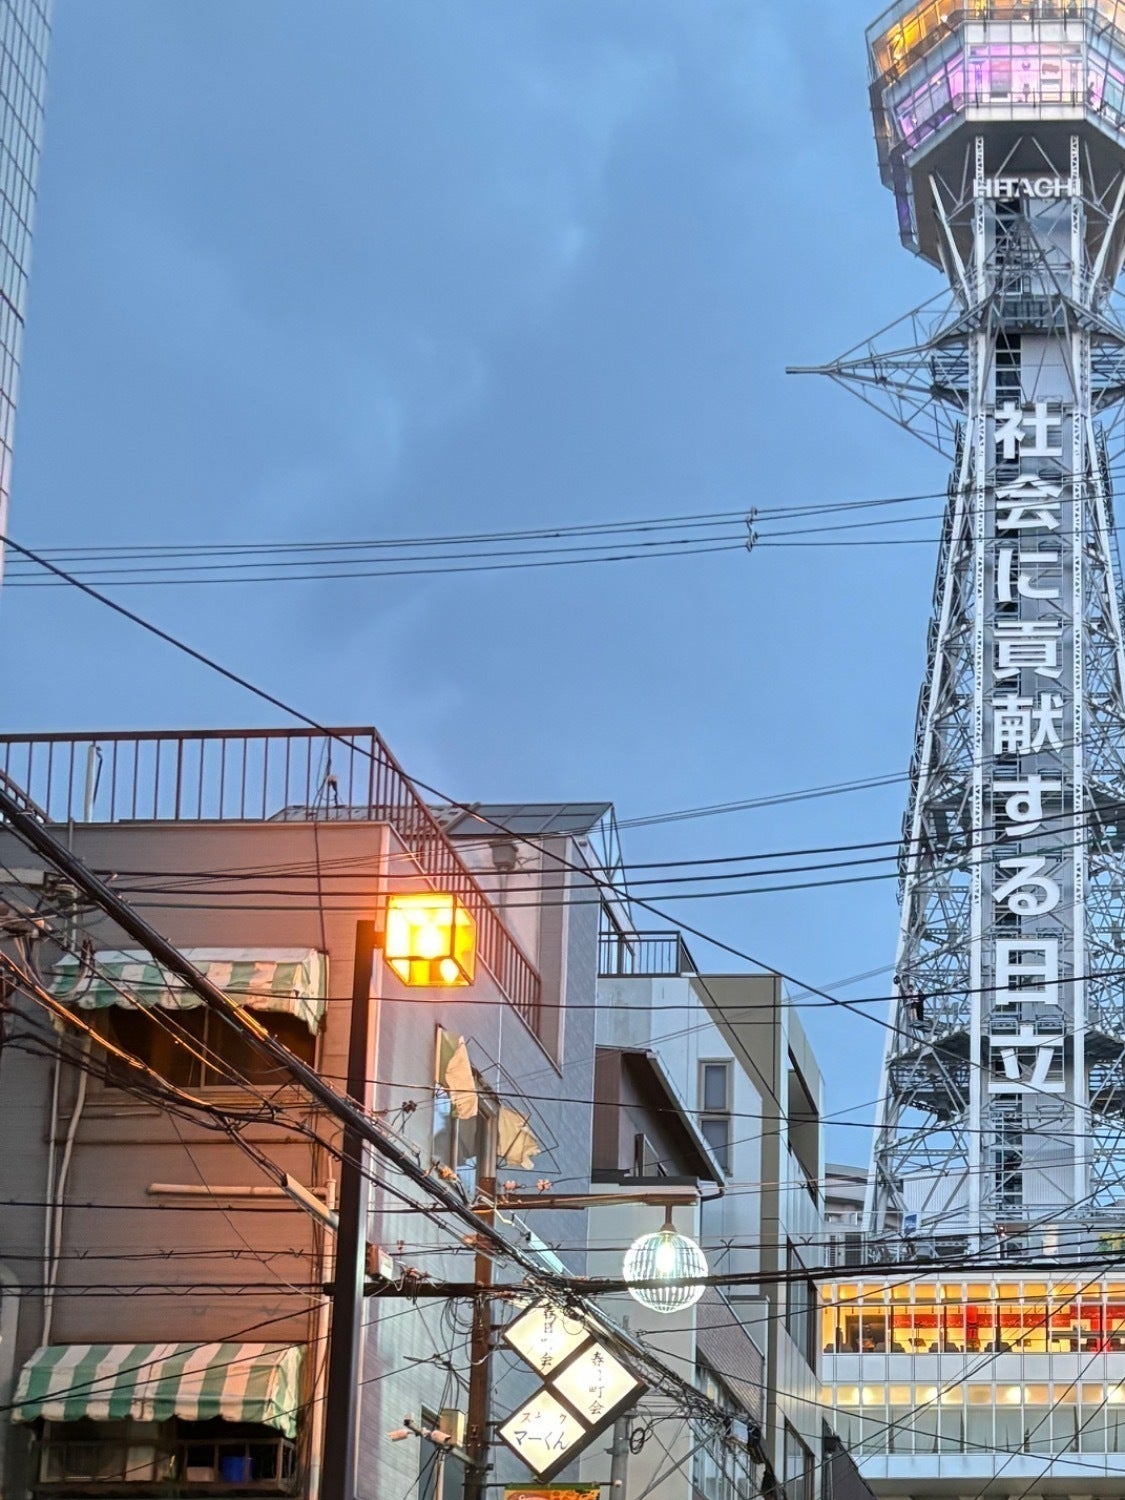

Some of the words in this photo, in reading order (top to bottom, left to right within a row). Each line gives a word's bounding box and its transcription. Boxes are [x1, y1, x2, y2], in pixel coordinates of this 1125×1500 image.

[973, 178, 1081, 198] HITACHI
[988, 401, 1066, 1094] 社会に貢献する日立
[588, 1350, 605, 1416] 春町会
[513, 1430, 570, 1451] マーくん
